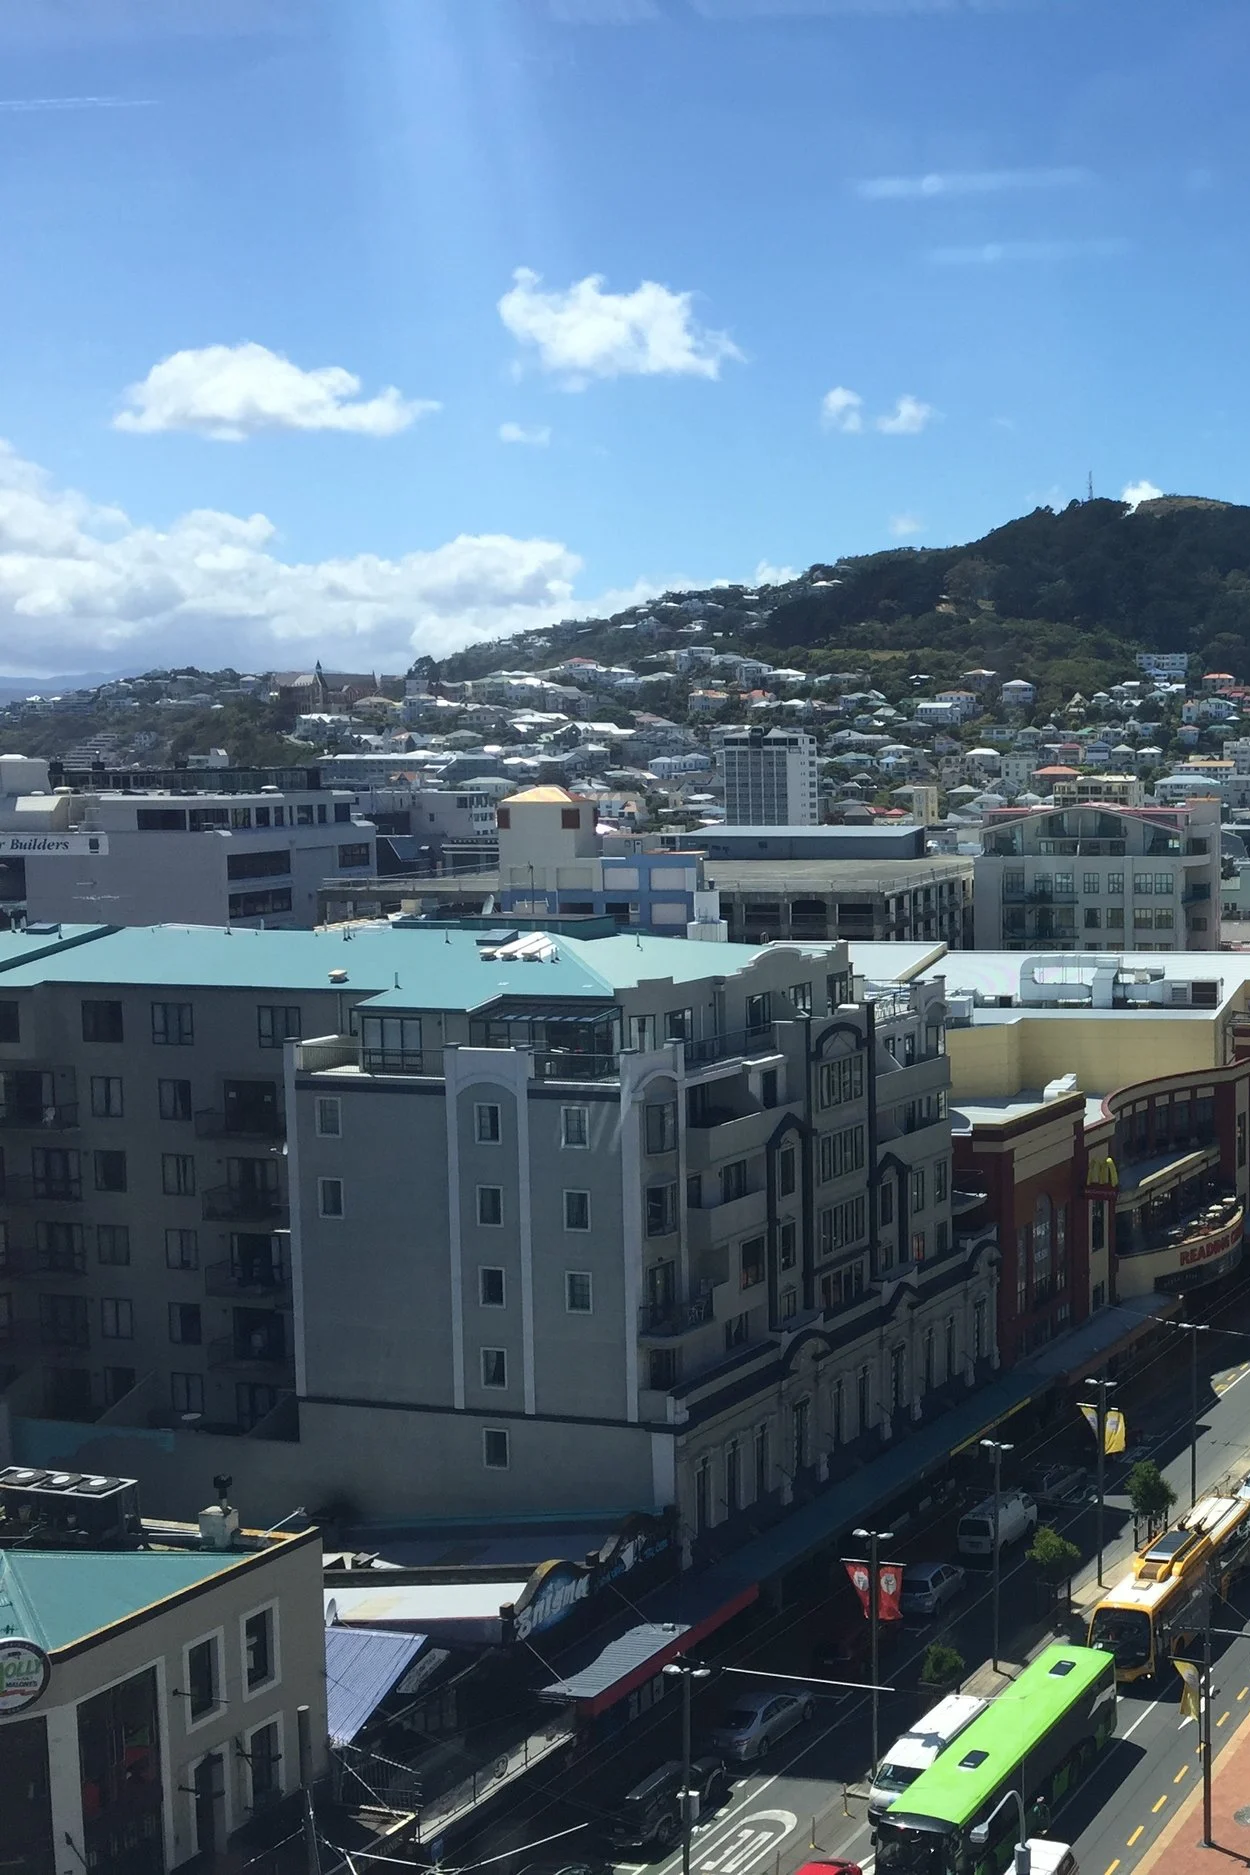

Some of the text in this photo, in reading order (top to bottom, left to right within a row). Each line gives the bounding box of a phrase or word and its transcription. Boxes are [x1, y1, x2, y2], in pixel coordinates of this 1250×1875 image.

[10, 838, 70, 850] Builders
[1180, 1234, 1230, 1266] READING
[700, 1828, 774, 1874] 30
